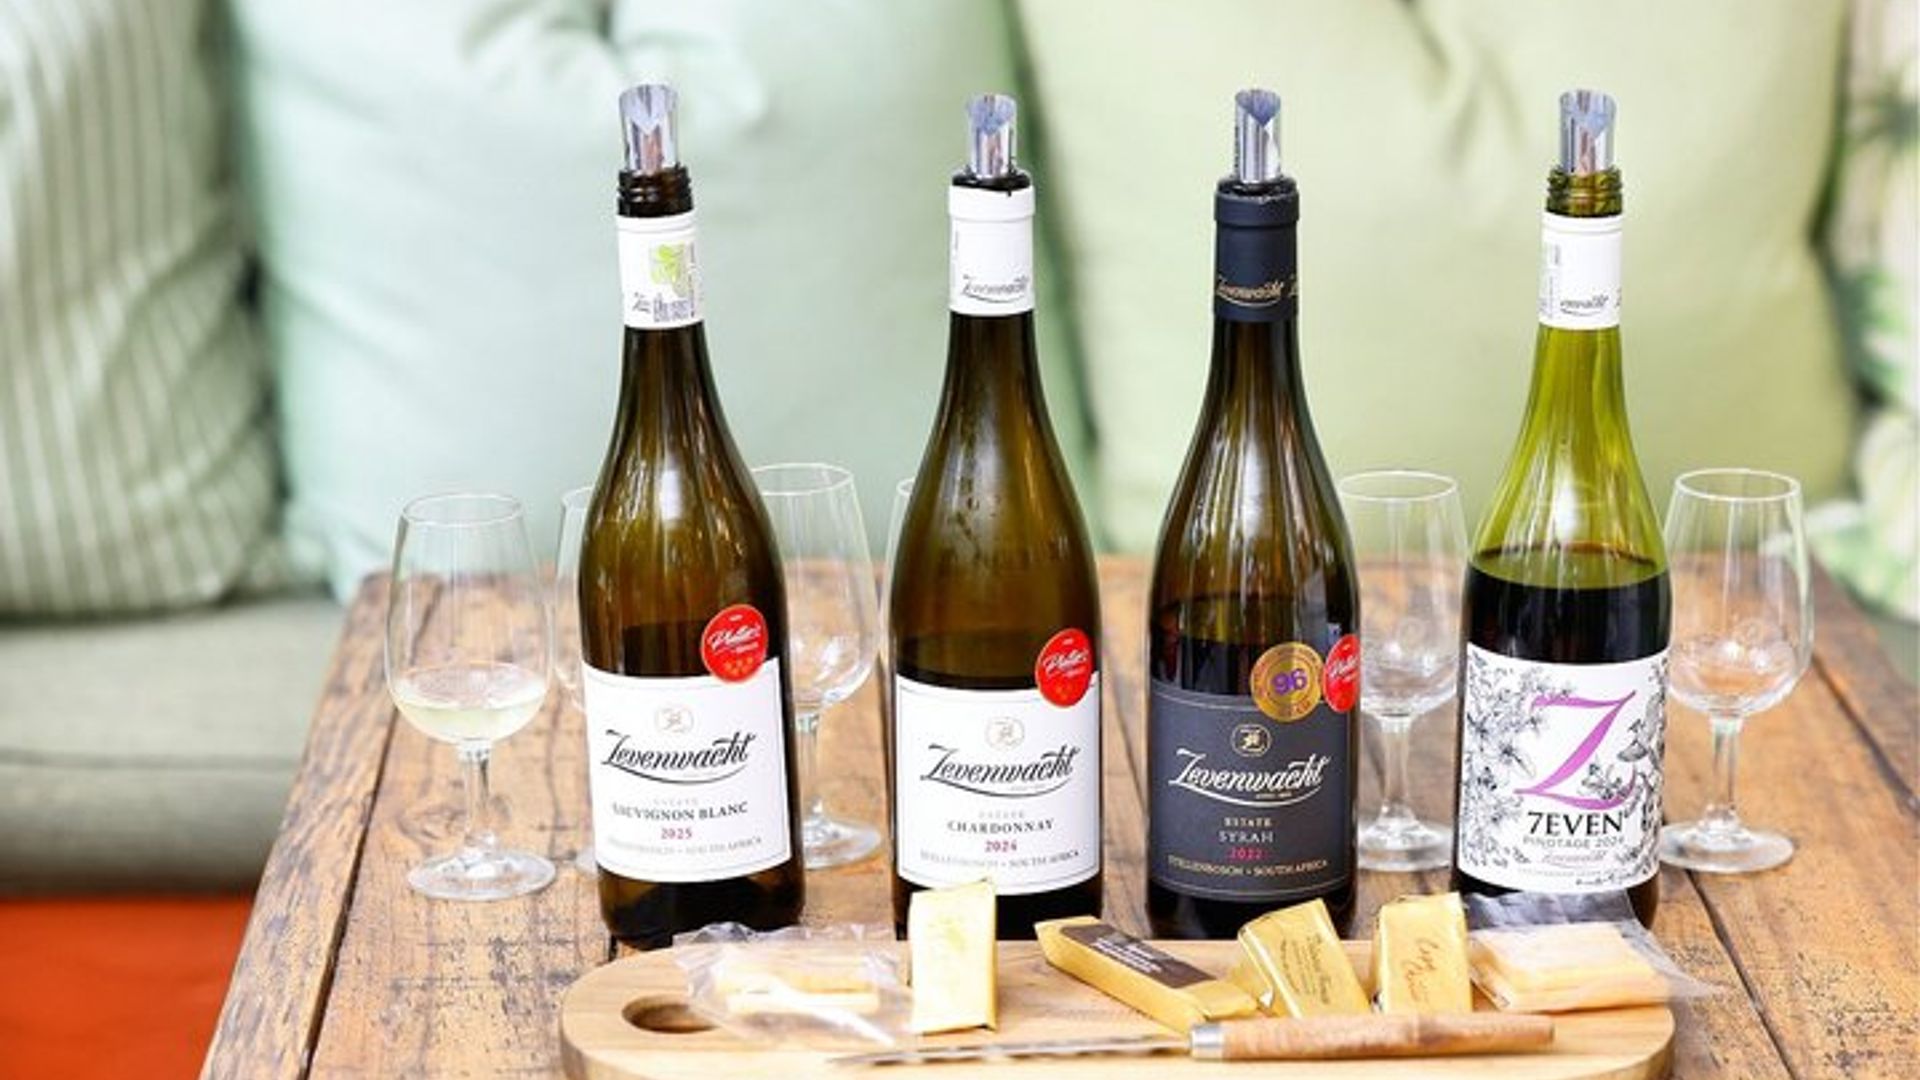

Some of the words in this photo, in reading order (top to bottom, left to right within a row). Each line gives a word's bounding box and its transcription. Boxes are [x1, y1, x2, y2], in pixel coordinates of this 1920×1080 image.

[1271, 668, 1307, 695] 96
[601, 729, 756, 785] Zevenwacht
[1513, 689, 1637, 811] Z
[920, 743, 1081, 798] Zevenwacht
[1168, 747, 1331, 807] Zevenwacht
[698, 800, 749, 821] BLANC
[1527, 811, 1623, 836] 7EVEN
[660, 827, 693, 840] 2025
[947, 817, 1054, 834] CHARDONNAY
[1218, 830, 1274, 844] SYRAH
